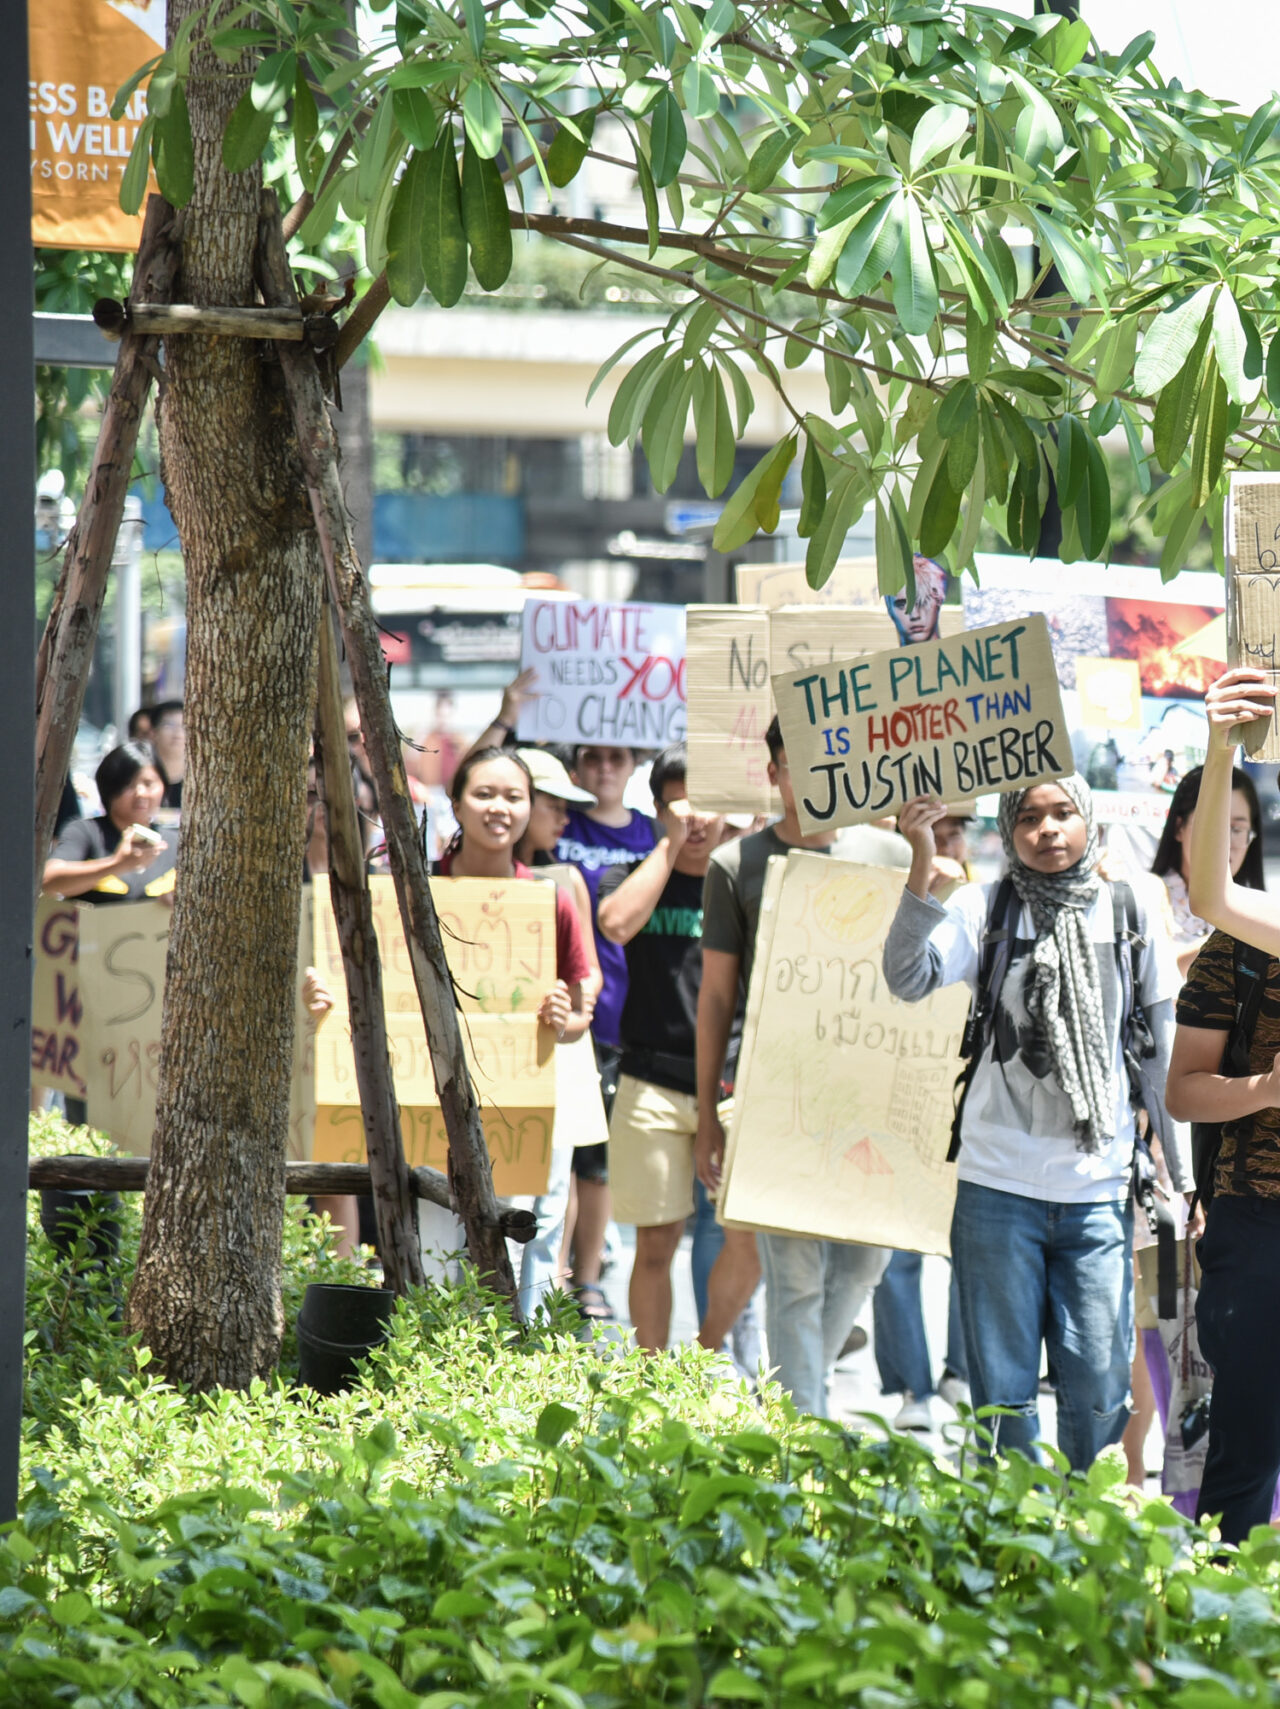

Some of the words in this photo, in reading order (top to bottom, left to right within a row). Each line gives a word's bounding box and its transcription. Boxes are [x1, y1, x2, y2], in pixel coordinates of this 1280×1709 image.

[532, 603, 654, 653] CLIMATE
[552, 658, 618, 686] NEEDS
[794, 664, 877, 725] THE
[889, 626, 1026, 701] PLANET
[822, 727, 850, 755] IS
[868, 698, 968, 752] HOTTER
[966, 684, 1031, 724] THAN
[803, 746, 943, 820] JUSTIN
[954, 719, 1062, 793] BIEBER
